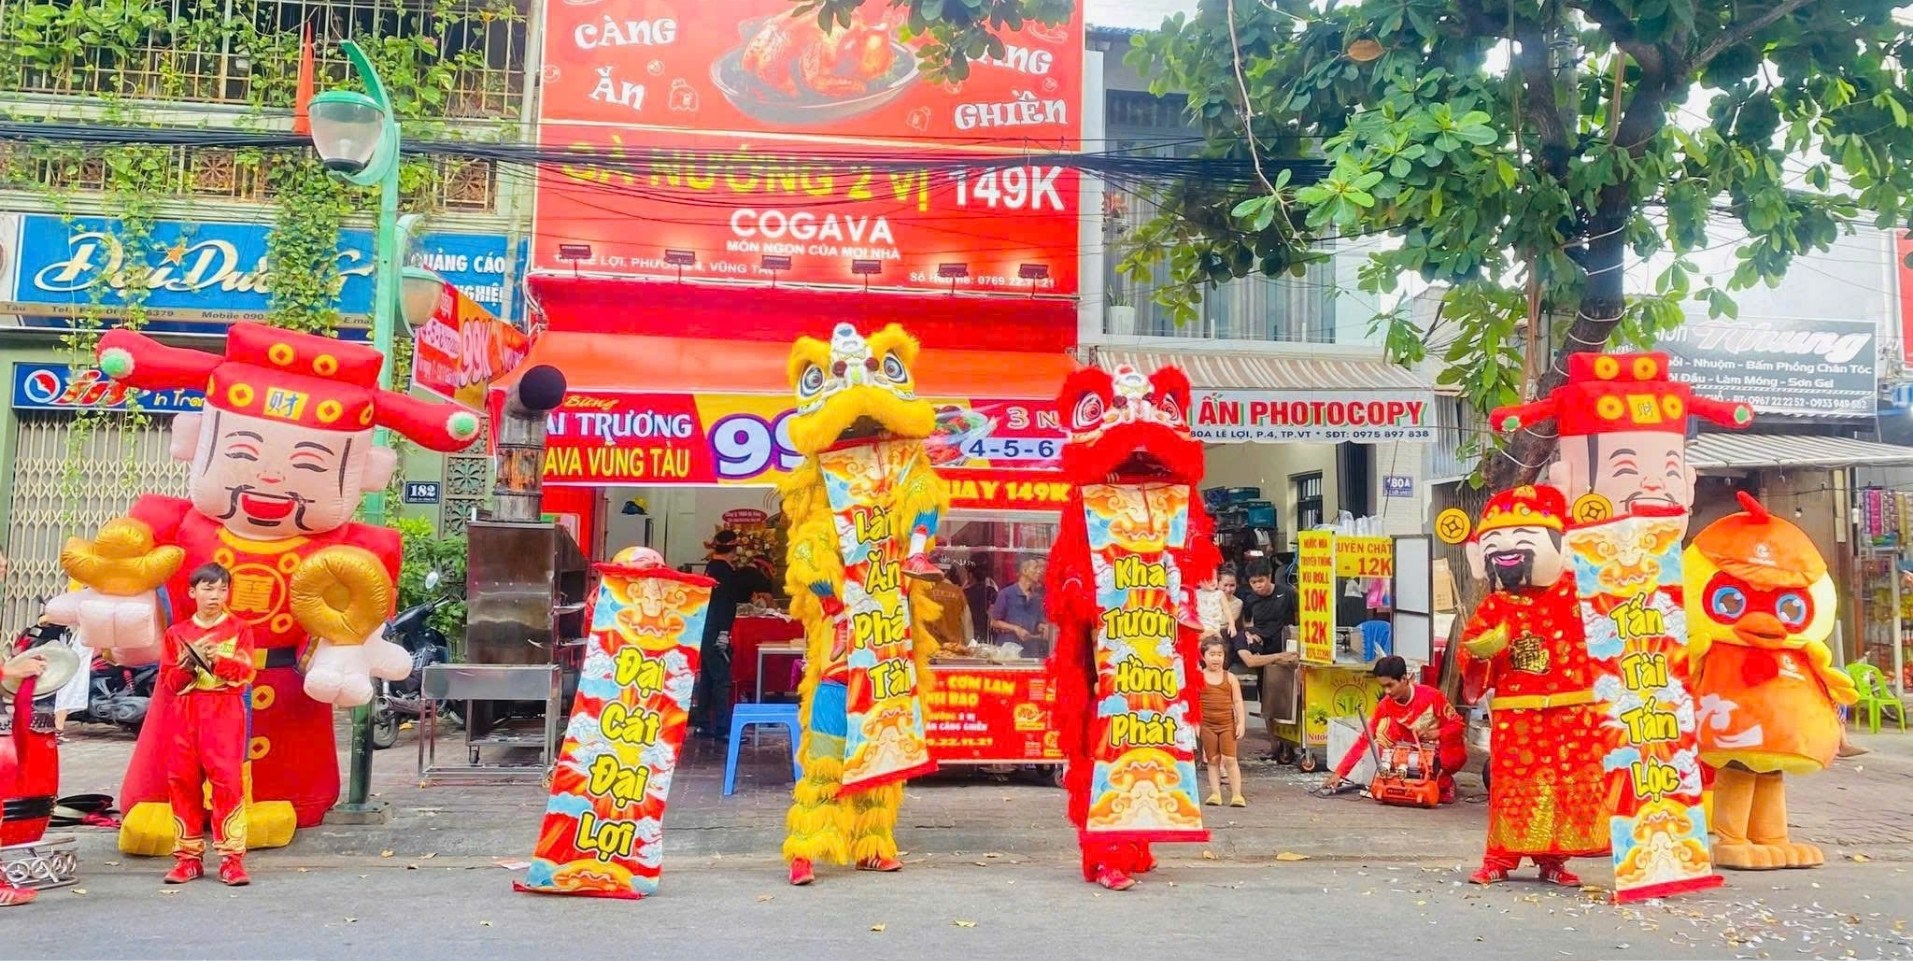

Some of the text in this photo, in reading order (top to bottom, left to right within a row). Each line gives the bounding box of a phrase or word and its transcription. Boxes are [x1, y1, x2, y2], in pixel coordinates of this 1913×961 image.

[964, 44, 1053, 74] NG
[848, 165, 872, 200] 2
[950, 163, 1065, 211] 149K
[730, 208, 894, 245] COGAVA
[473, 251, 506, 273] CÁO
[710, 261, 747, 273] VŨNG
[727, 239, 760, 252] MÓN
[763, 241, 805, 255] NGON
[808, 244, 838, 257] CỦA
[871, 246, 900, 260] NHÀ
[460, 318, 492, 388] 99K
[575, 409, 693, 445] TRƯƠNG
[1007, 406, 1031, 430] 3
[1250, 401, 1426, 426] PHOTOCOPY
[1353, 430, 1381, 438] 0975
[1384, 430, 1404, 438] 897
[1408, 429, 1430, 438] 838
[650, 439, 690, 478] TÀU
[410, 485, 435, 497] 182
[1005, 482, 1072, 502] 149K
[1337, 540, 1364, 554] UYÊN
[1114, 556, 1167, 590] Kha
[1358, 557, 1393, 576] 12K
[1303, 588, 1328, 613] 10K
[1609, 592, 1665, 639] Tấn
[853, 605, 905, 650] Phá
[1304, 620, 1328, 645] 12K
[614, 647, 666, 698] Đại
[1114, 654, 1178, 698] Hồng
[1621, 653, 1668, 690] Tài
[599, 702, 661, 746] Cát
[1111, 711, 1178, 746] Phát
[1620, 696, 1679, 744] Tấn
[589, 754, 650, 810] Đại
[1631, 756, 1680, 802] Lộc
[575, 812, 637, 862] Lợi
